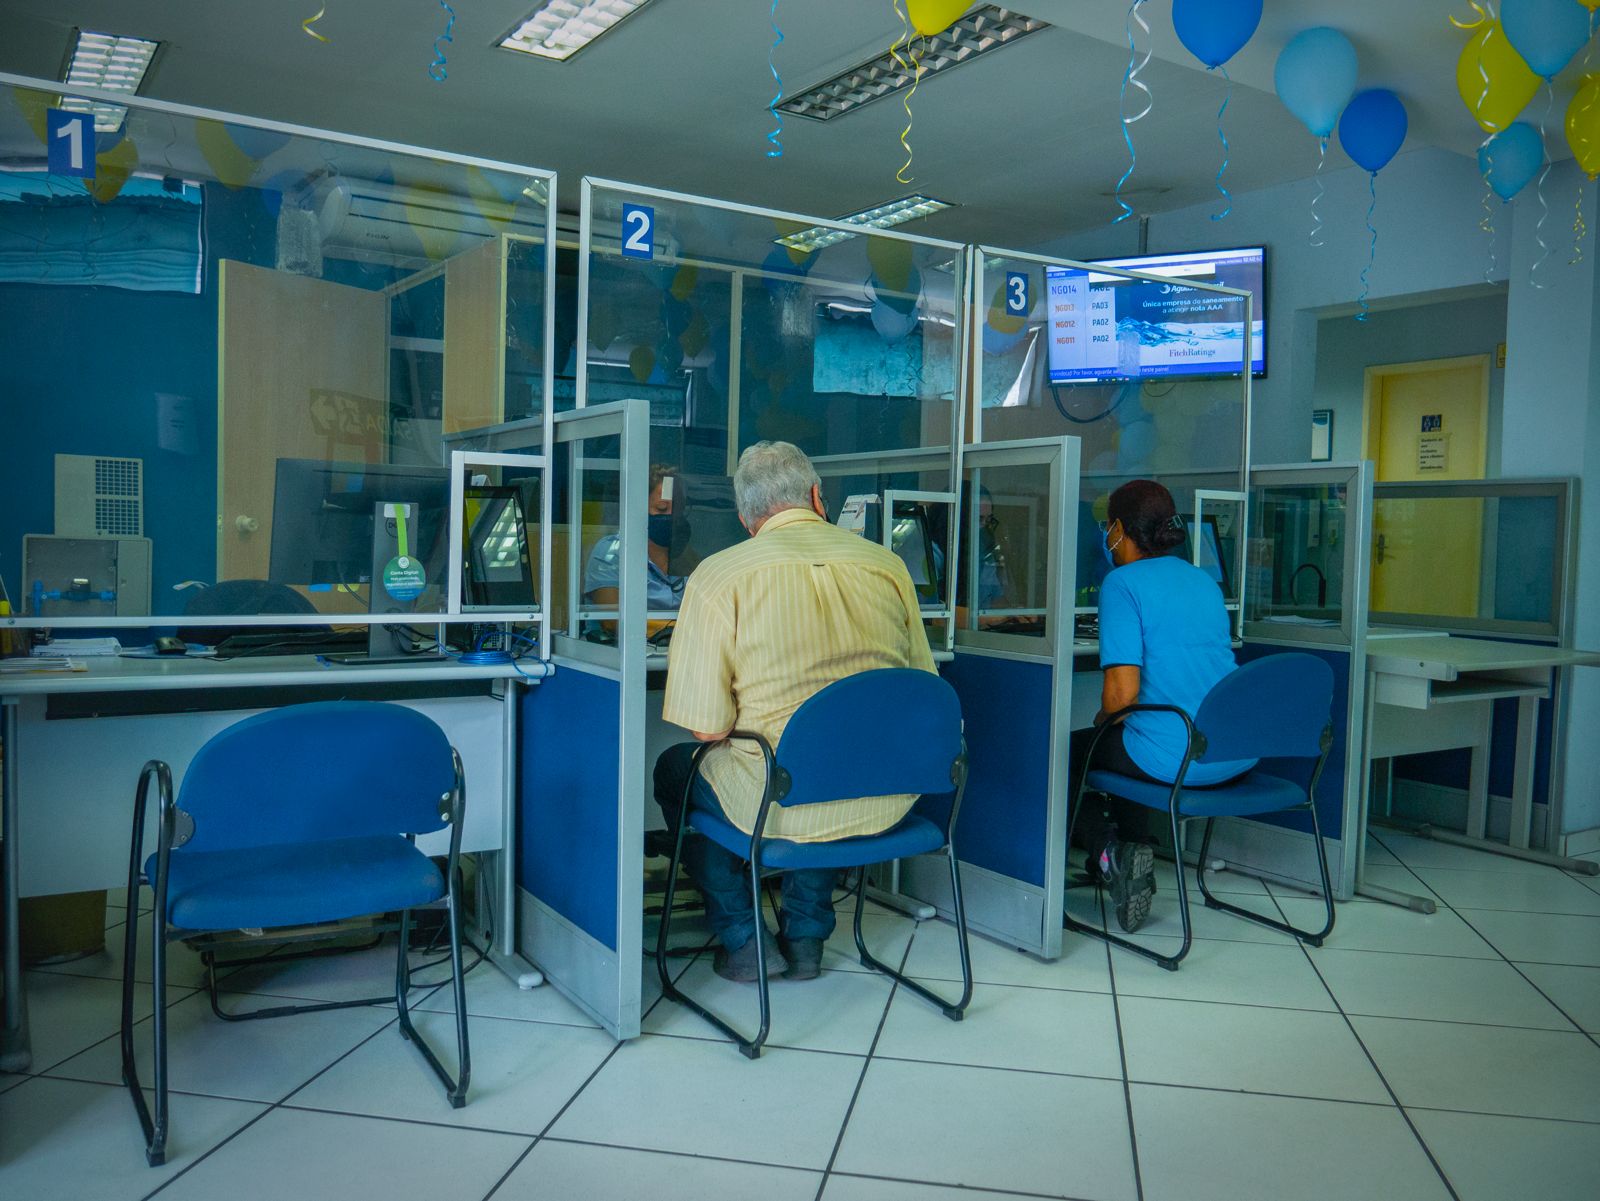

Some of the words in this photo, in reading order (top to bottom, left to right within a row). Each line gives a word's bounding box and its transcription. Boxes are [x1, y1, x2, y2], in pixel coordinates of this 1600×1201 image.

[57, 118, 83, 169] 1
[625, 210, 650, 252] 2
[1009, 276, 1026, 311] 3
[1051, 285, 1077, 295] NG014
[1092, 302, 1109, 310] PA03
[1142, 300, 1161, 308] Única
[1202, 296, 1244, 304] saneamento
[1092, 335, 1109, 343] PA02
